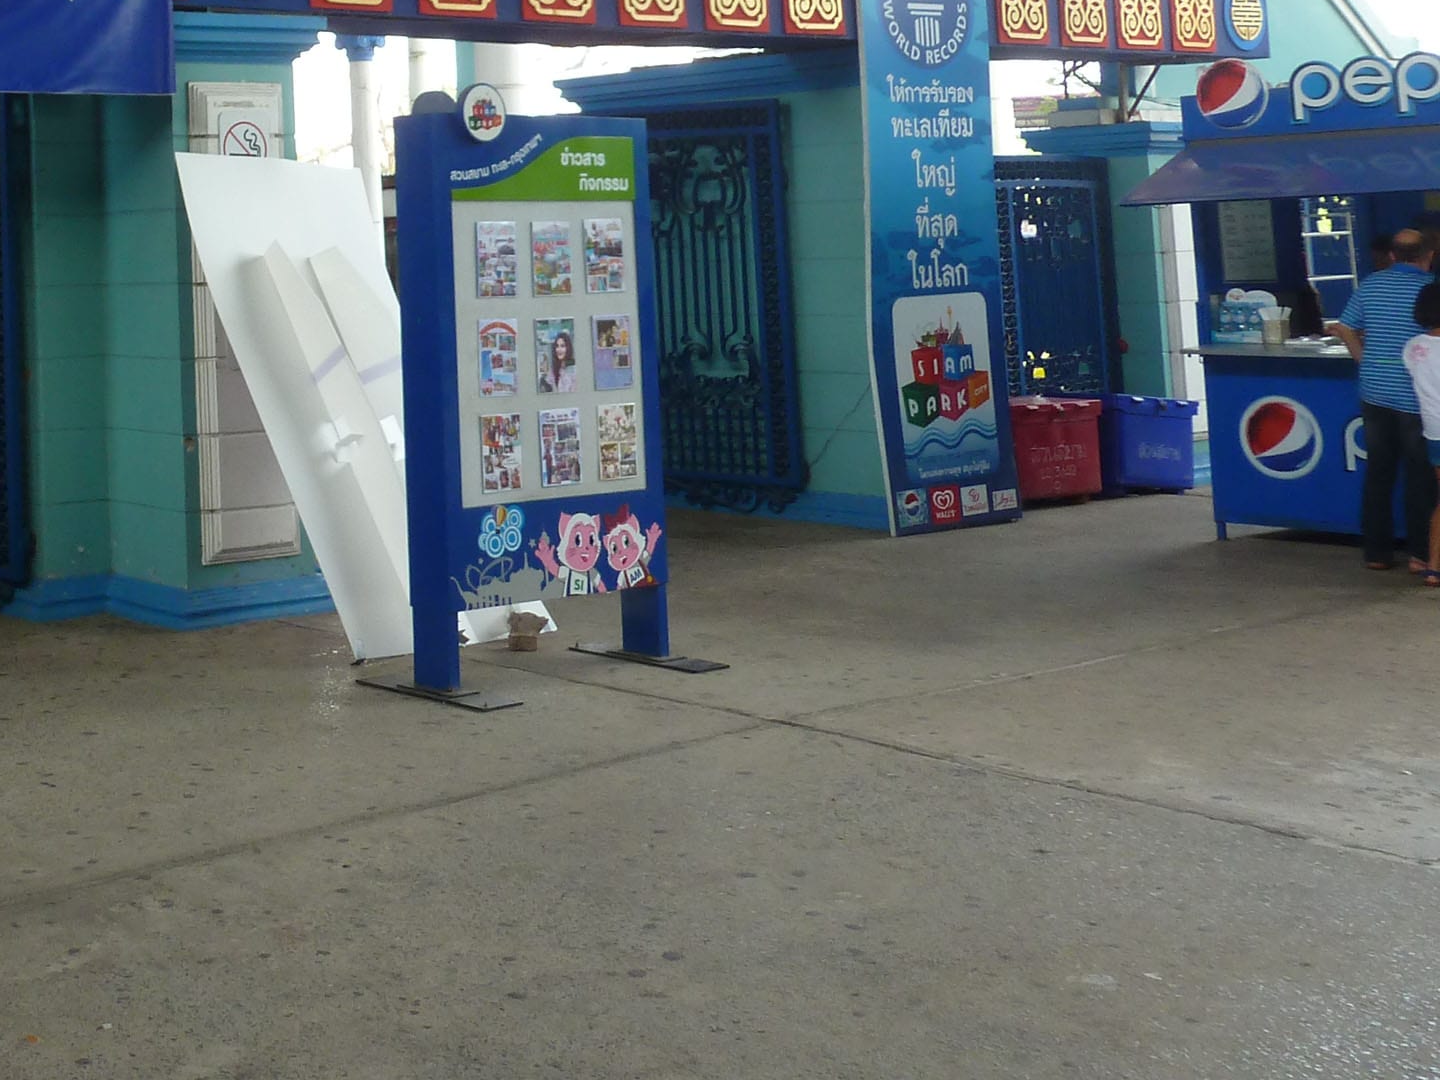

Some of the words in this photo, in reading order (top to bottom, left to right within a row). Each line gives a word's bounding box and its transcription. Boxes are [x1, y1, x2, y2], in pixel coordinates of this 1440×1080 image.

[883, 0, 921, 61] WORLD
[926, 2, 967, 65] RECORDS
[886, 74, 974, 104] ให้การรับรอง
[891, 110, 973, 138] ทะเลเทียม
[560, 147, 606, 166] ข่าวสาร
[579, 173, 629, 191] กิจกรรม
[911, 149, 955, 197] ใหญ่
[915, 196, 958, 249] ที่สุด
[907, 248, 969, 290] ในโลก
[918, 352, 973, 377] SIAM
[908, 389, 967, 418] PARK
[574, 579, 585, 591] SI
[629, 569, 643, 584] AM
